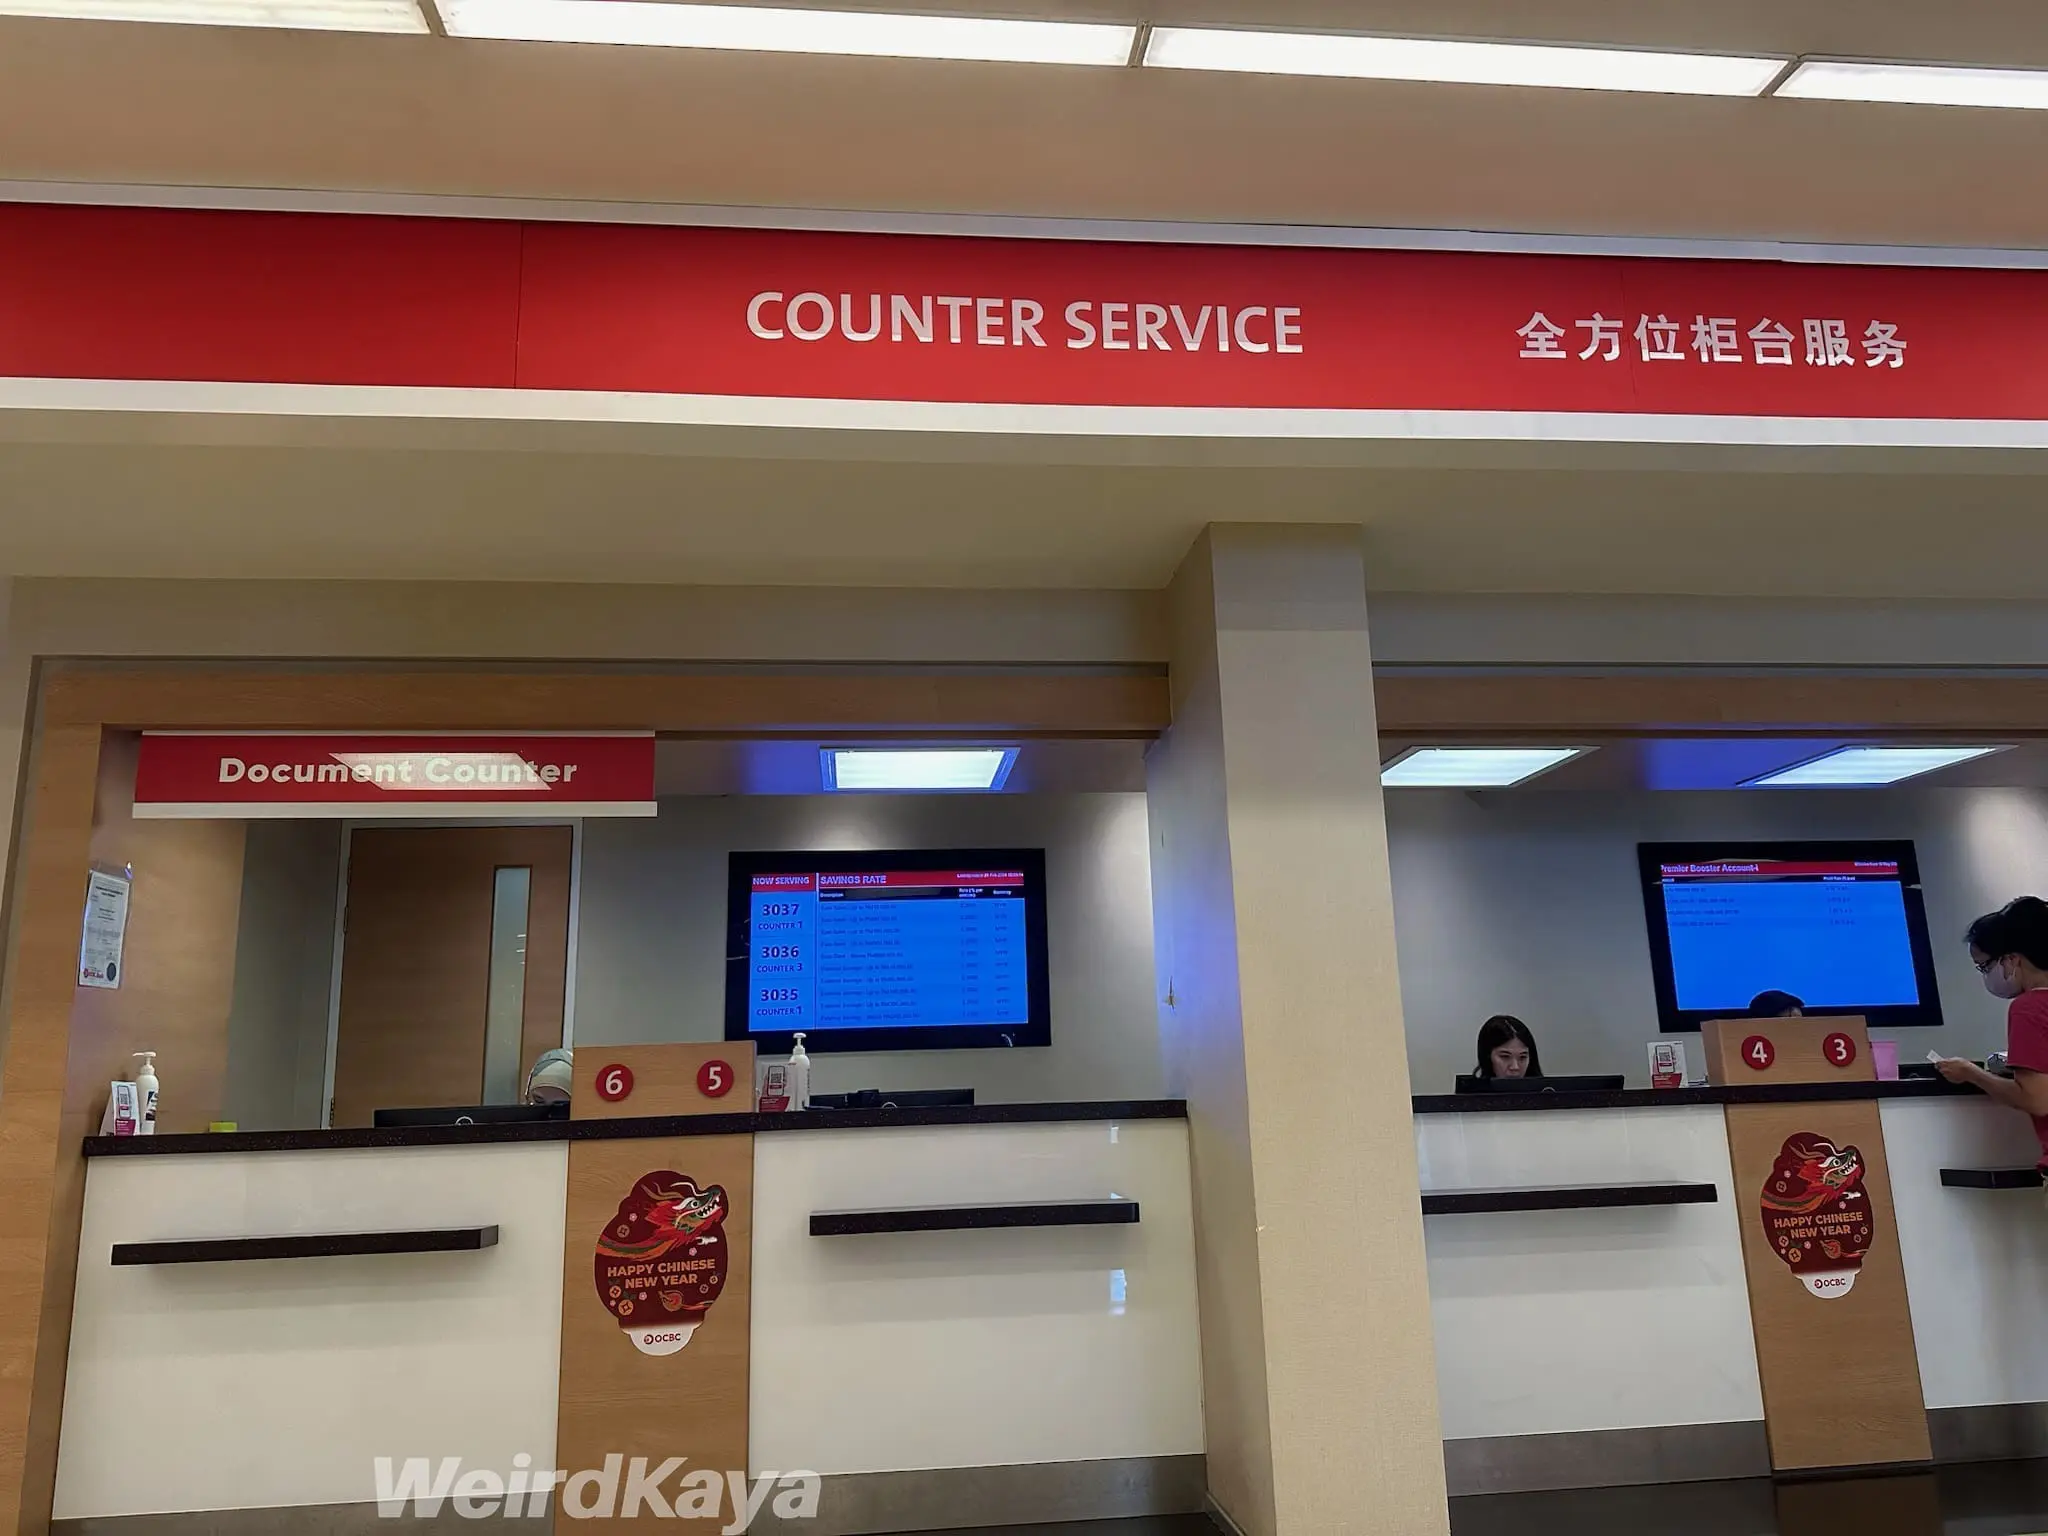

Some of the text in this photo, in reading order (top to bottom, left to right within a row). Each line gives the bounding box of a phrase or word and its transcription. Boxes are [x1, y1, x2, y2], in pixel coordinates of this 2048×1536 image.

[745, 290, 1305, 355] COUNTER SERVICE
[1515, 311, 1908, 369] 全方位柜台服务
[218, 756, 578, 784] Document Counter
[752, 876, 810, 885] NOW SERVING
[820, 874, 887, 885] SAVINGS RATE
[762, 903, 800, 916] 3037
[758, 922, 795, 930] COUNTER
[762, 946, 800, 959] 3036
[756, 962, 803, 973] COUNTER 3
[760, 988, 798, 1001] 3035
[756, 1007, 794, 1016] COUNTER
[1751, 1040, 1768, 1063] 4
[1833, 1038, 1847, 1061] 3
[605, 1070, 623, 1095] 6
[707, 1065, 722, 1091] 5
[1773, 1211, 1864, 1228] HAPPY CHINESE
[1790, 1224, 1852, 1239] NEW YEAR
[607, 1258, 716, 1277] HAPPY CHINESE
[625, 1273, 698, 1289] NEW YEAR
[1823, 1278, 1847, 1287] OCBC
[654, 1333, 681, 1343] OCBC
